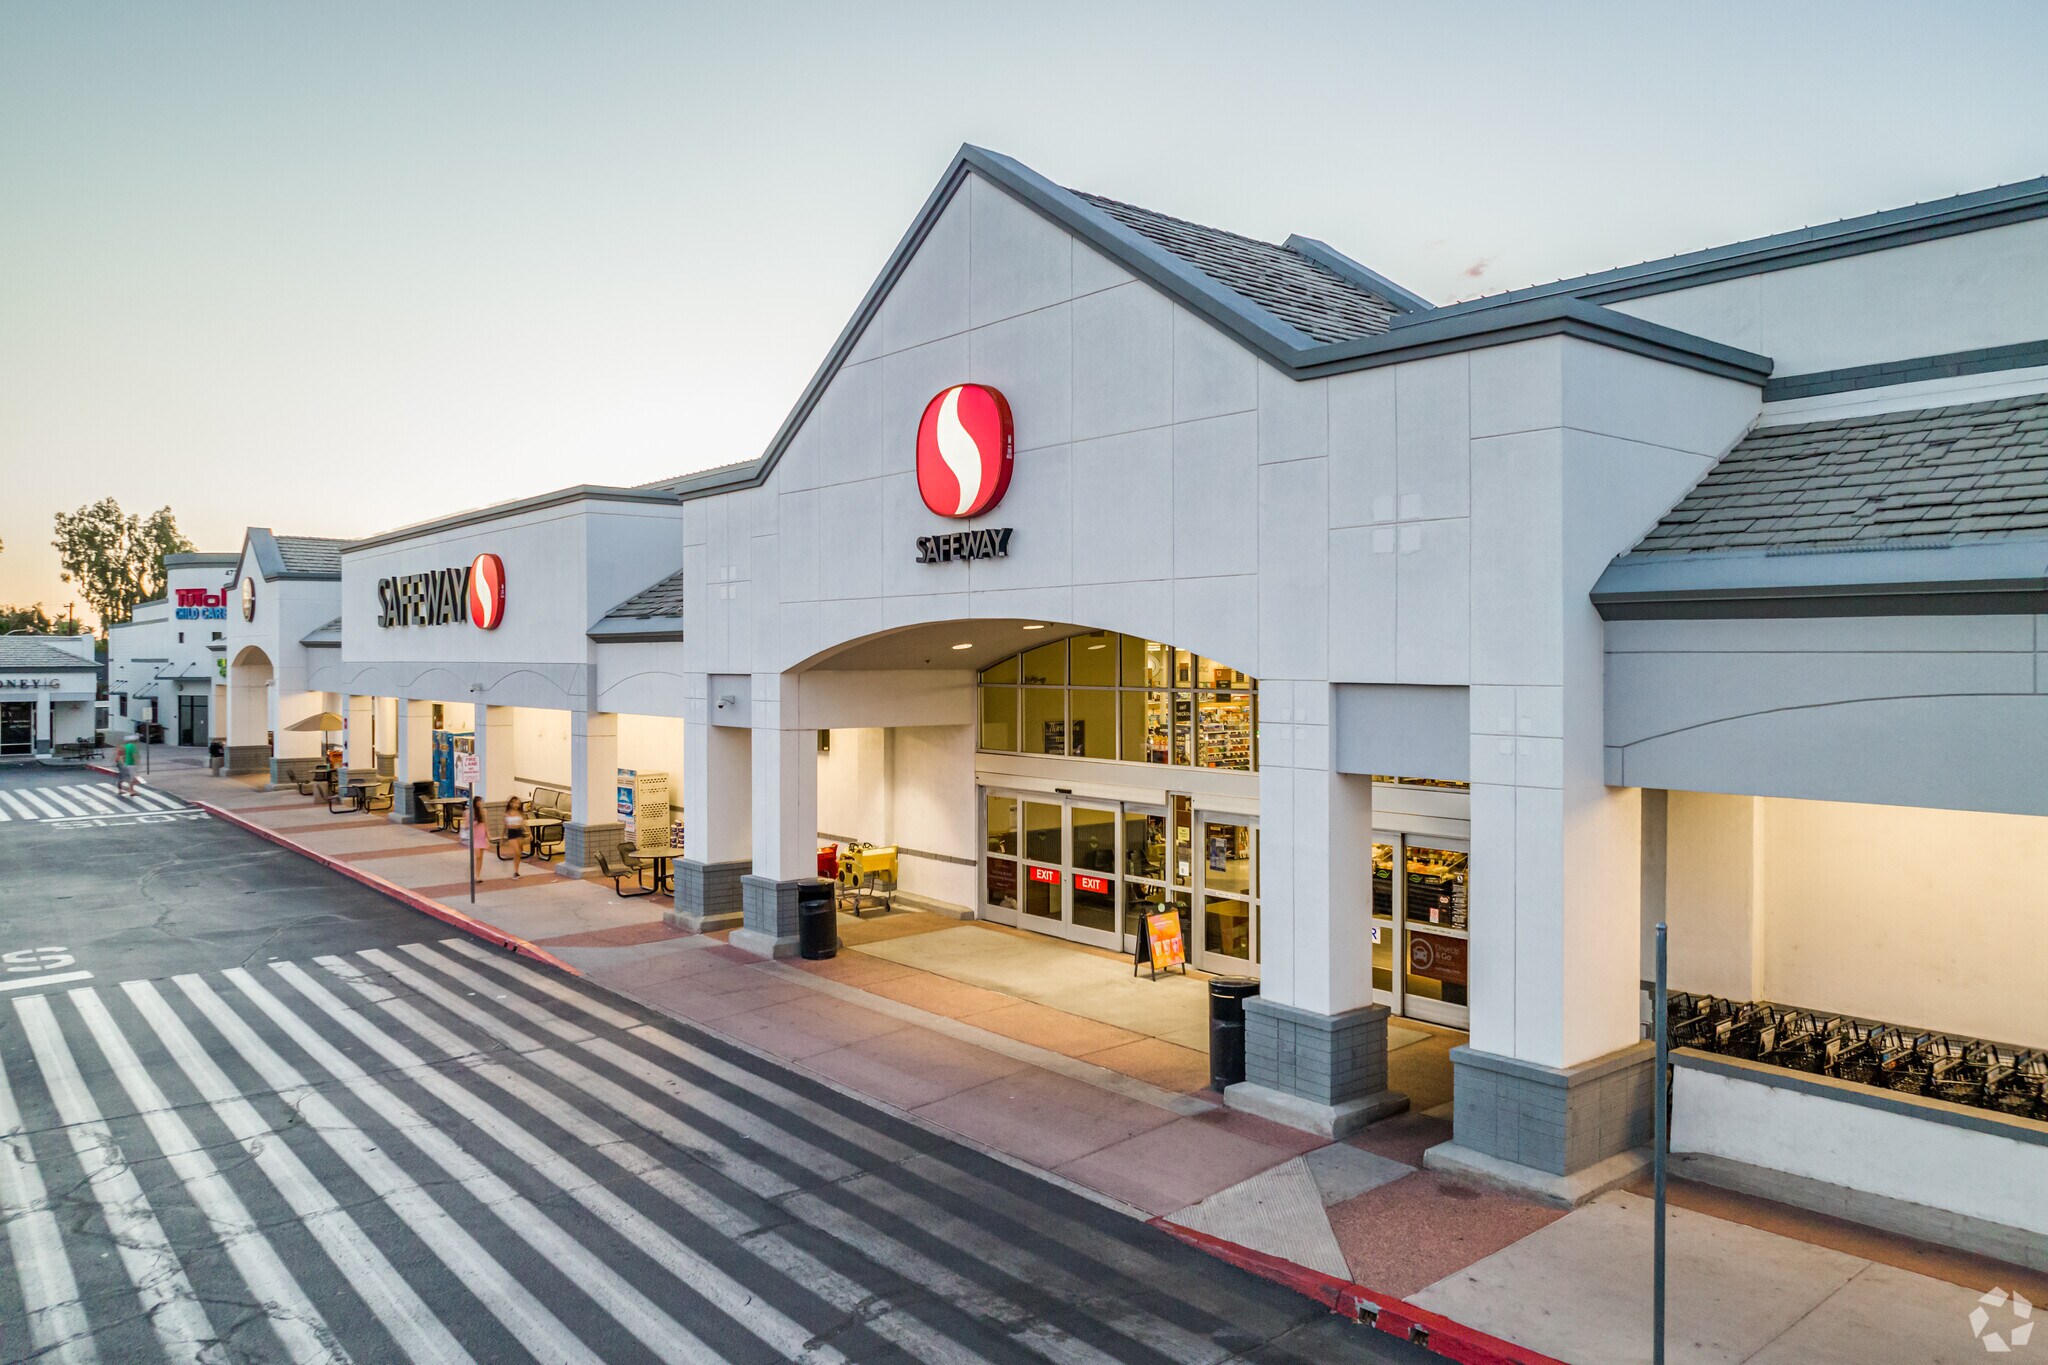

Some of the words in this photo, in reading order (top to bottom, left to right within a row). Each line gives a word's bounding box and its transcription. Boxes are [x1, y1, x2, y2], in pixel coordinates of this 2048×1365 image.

[916, 528, 1013, 563] SAFEWAY
[377, 566, 472, 628] SAFEWAY
[175, 607, 200, 620] CHILD
[1036, 869, 1053, 881] EXIT
[1082, 877, 1101, 889] EXIT
[1441, 952, 1452, 961] Go
